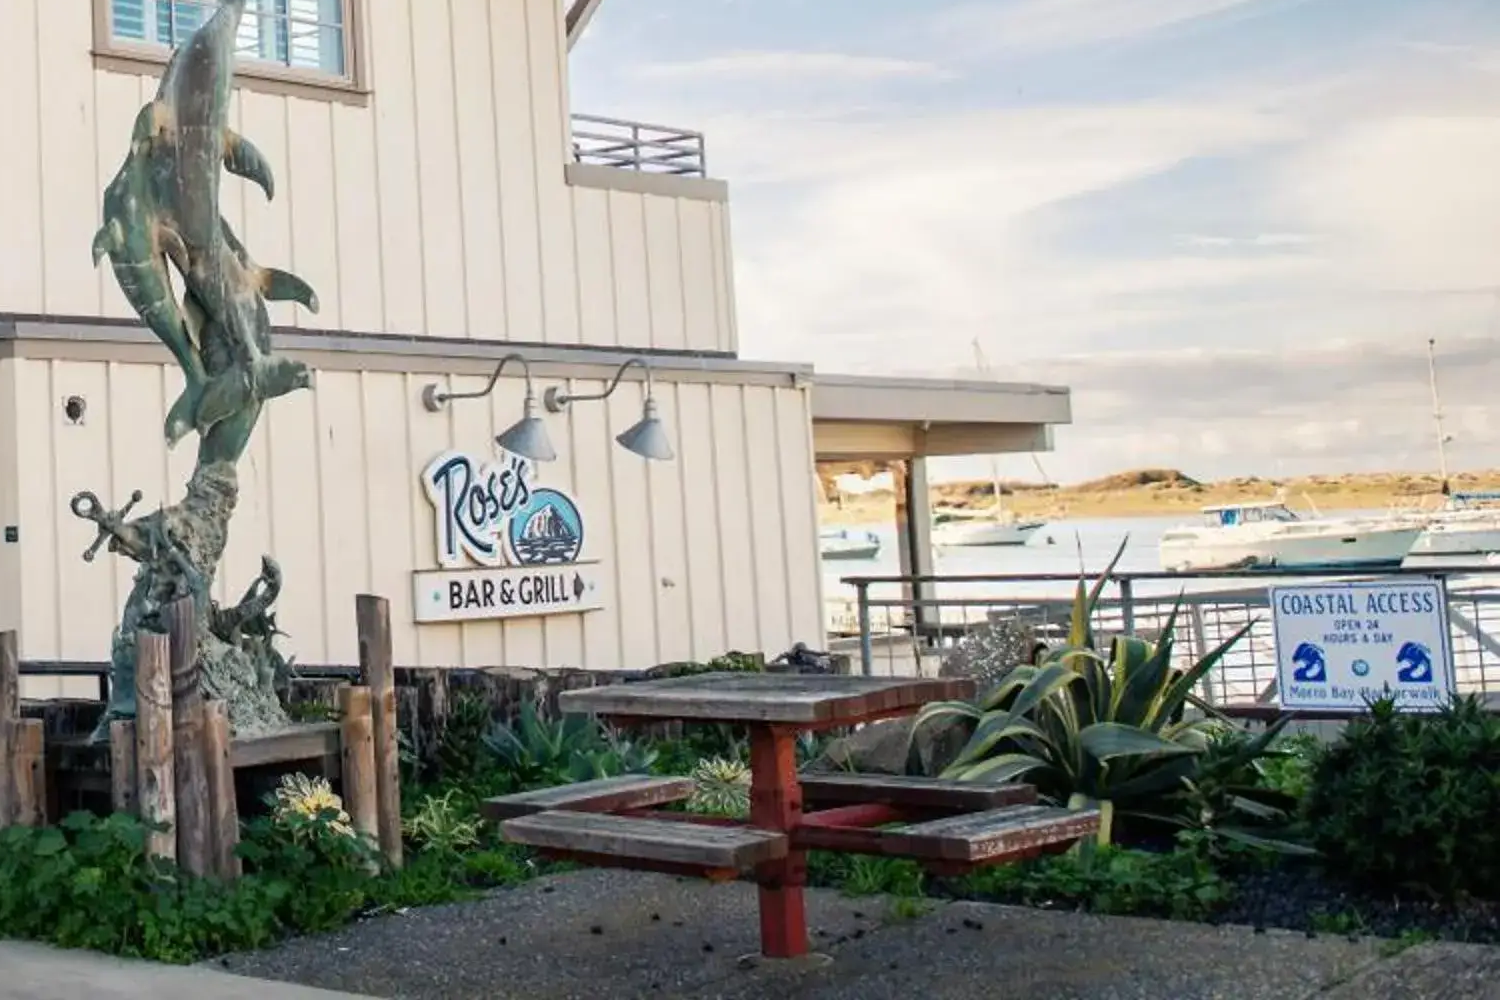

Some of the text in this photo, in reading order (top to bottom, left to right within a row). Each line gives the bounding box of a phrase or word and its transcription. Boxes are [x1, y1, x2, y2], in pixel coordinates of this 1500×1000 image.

[432, 456, 530, 555] Rose's
[449, 573, 569, 609] BAR & GRILL
[1281, 591, 1434, 615] COASTAL ACCESS
[1333, 618, 1379, 630] OPEN 24
[1323, 632, 1358, 643] HOURS
[1373, 632, 1394, 643] DAY
[1289, 685, 1328, 699] Morro
[1332, 686, 1355, 700] Bay
